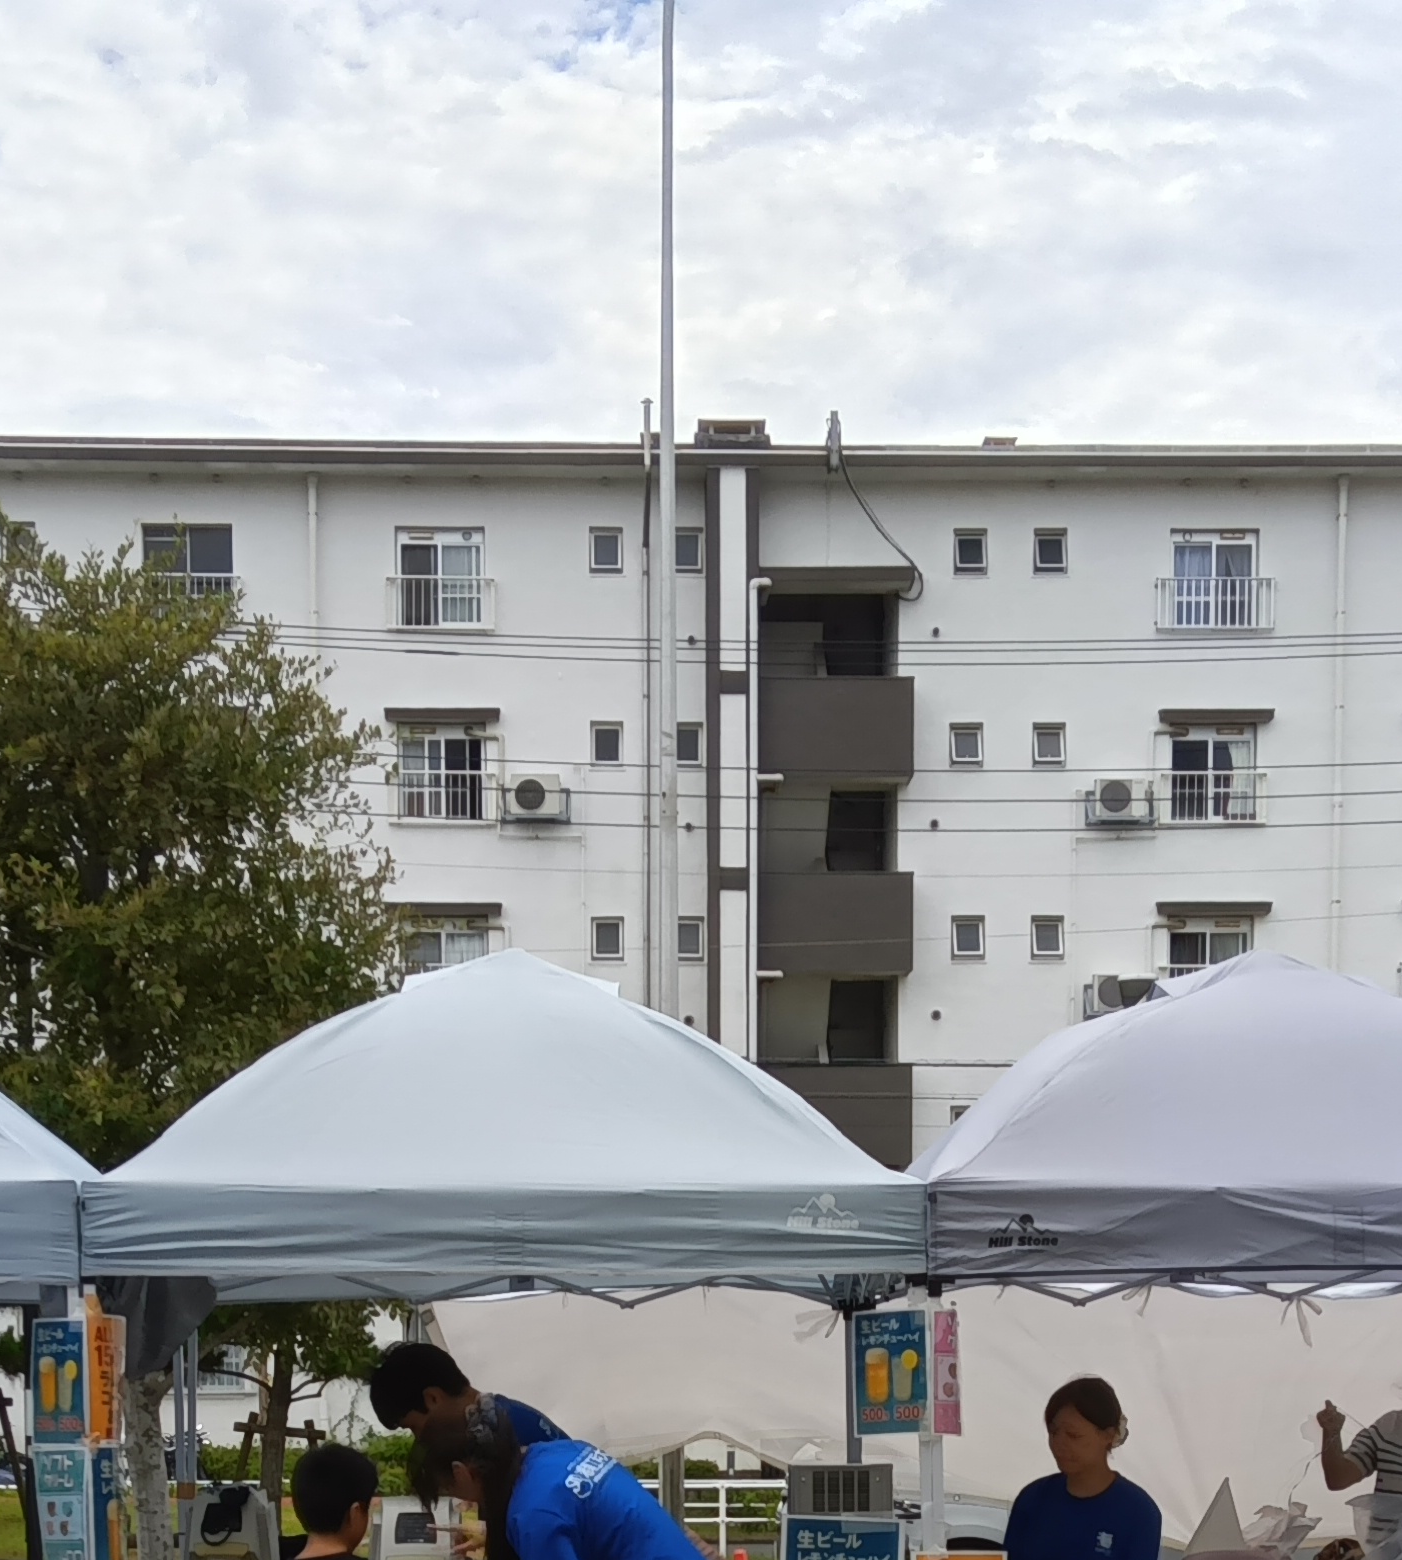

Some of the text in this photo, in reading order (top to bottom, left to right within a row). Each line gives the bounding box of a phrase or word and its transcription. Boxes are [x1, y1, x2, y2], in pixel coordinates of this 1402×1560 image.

[786, 1216, 860, 1230] Hill Stone
[988, 1235, 1058, 1248] Hill Stone
[861, 1318, 900, 1334] 生ビール
[861, 1331, 920, 1346] レモンチューハイ
[796, 1529, 862, 1549] 生ビール
